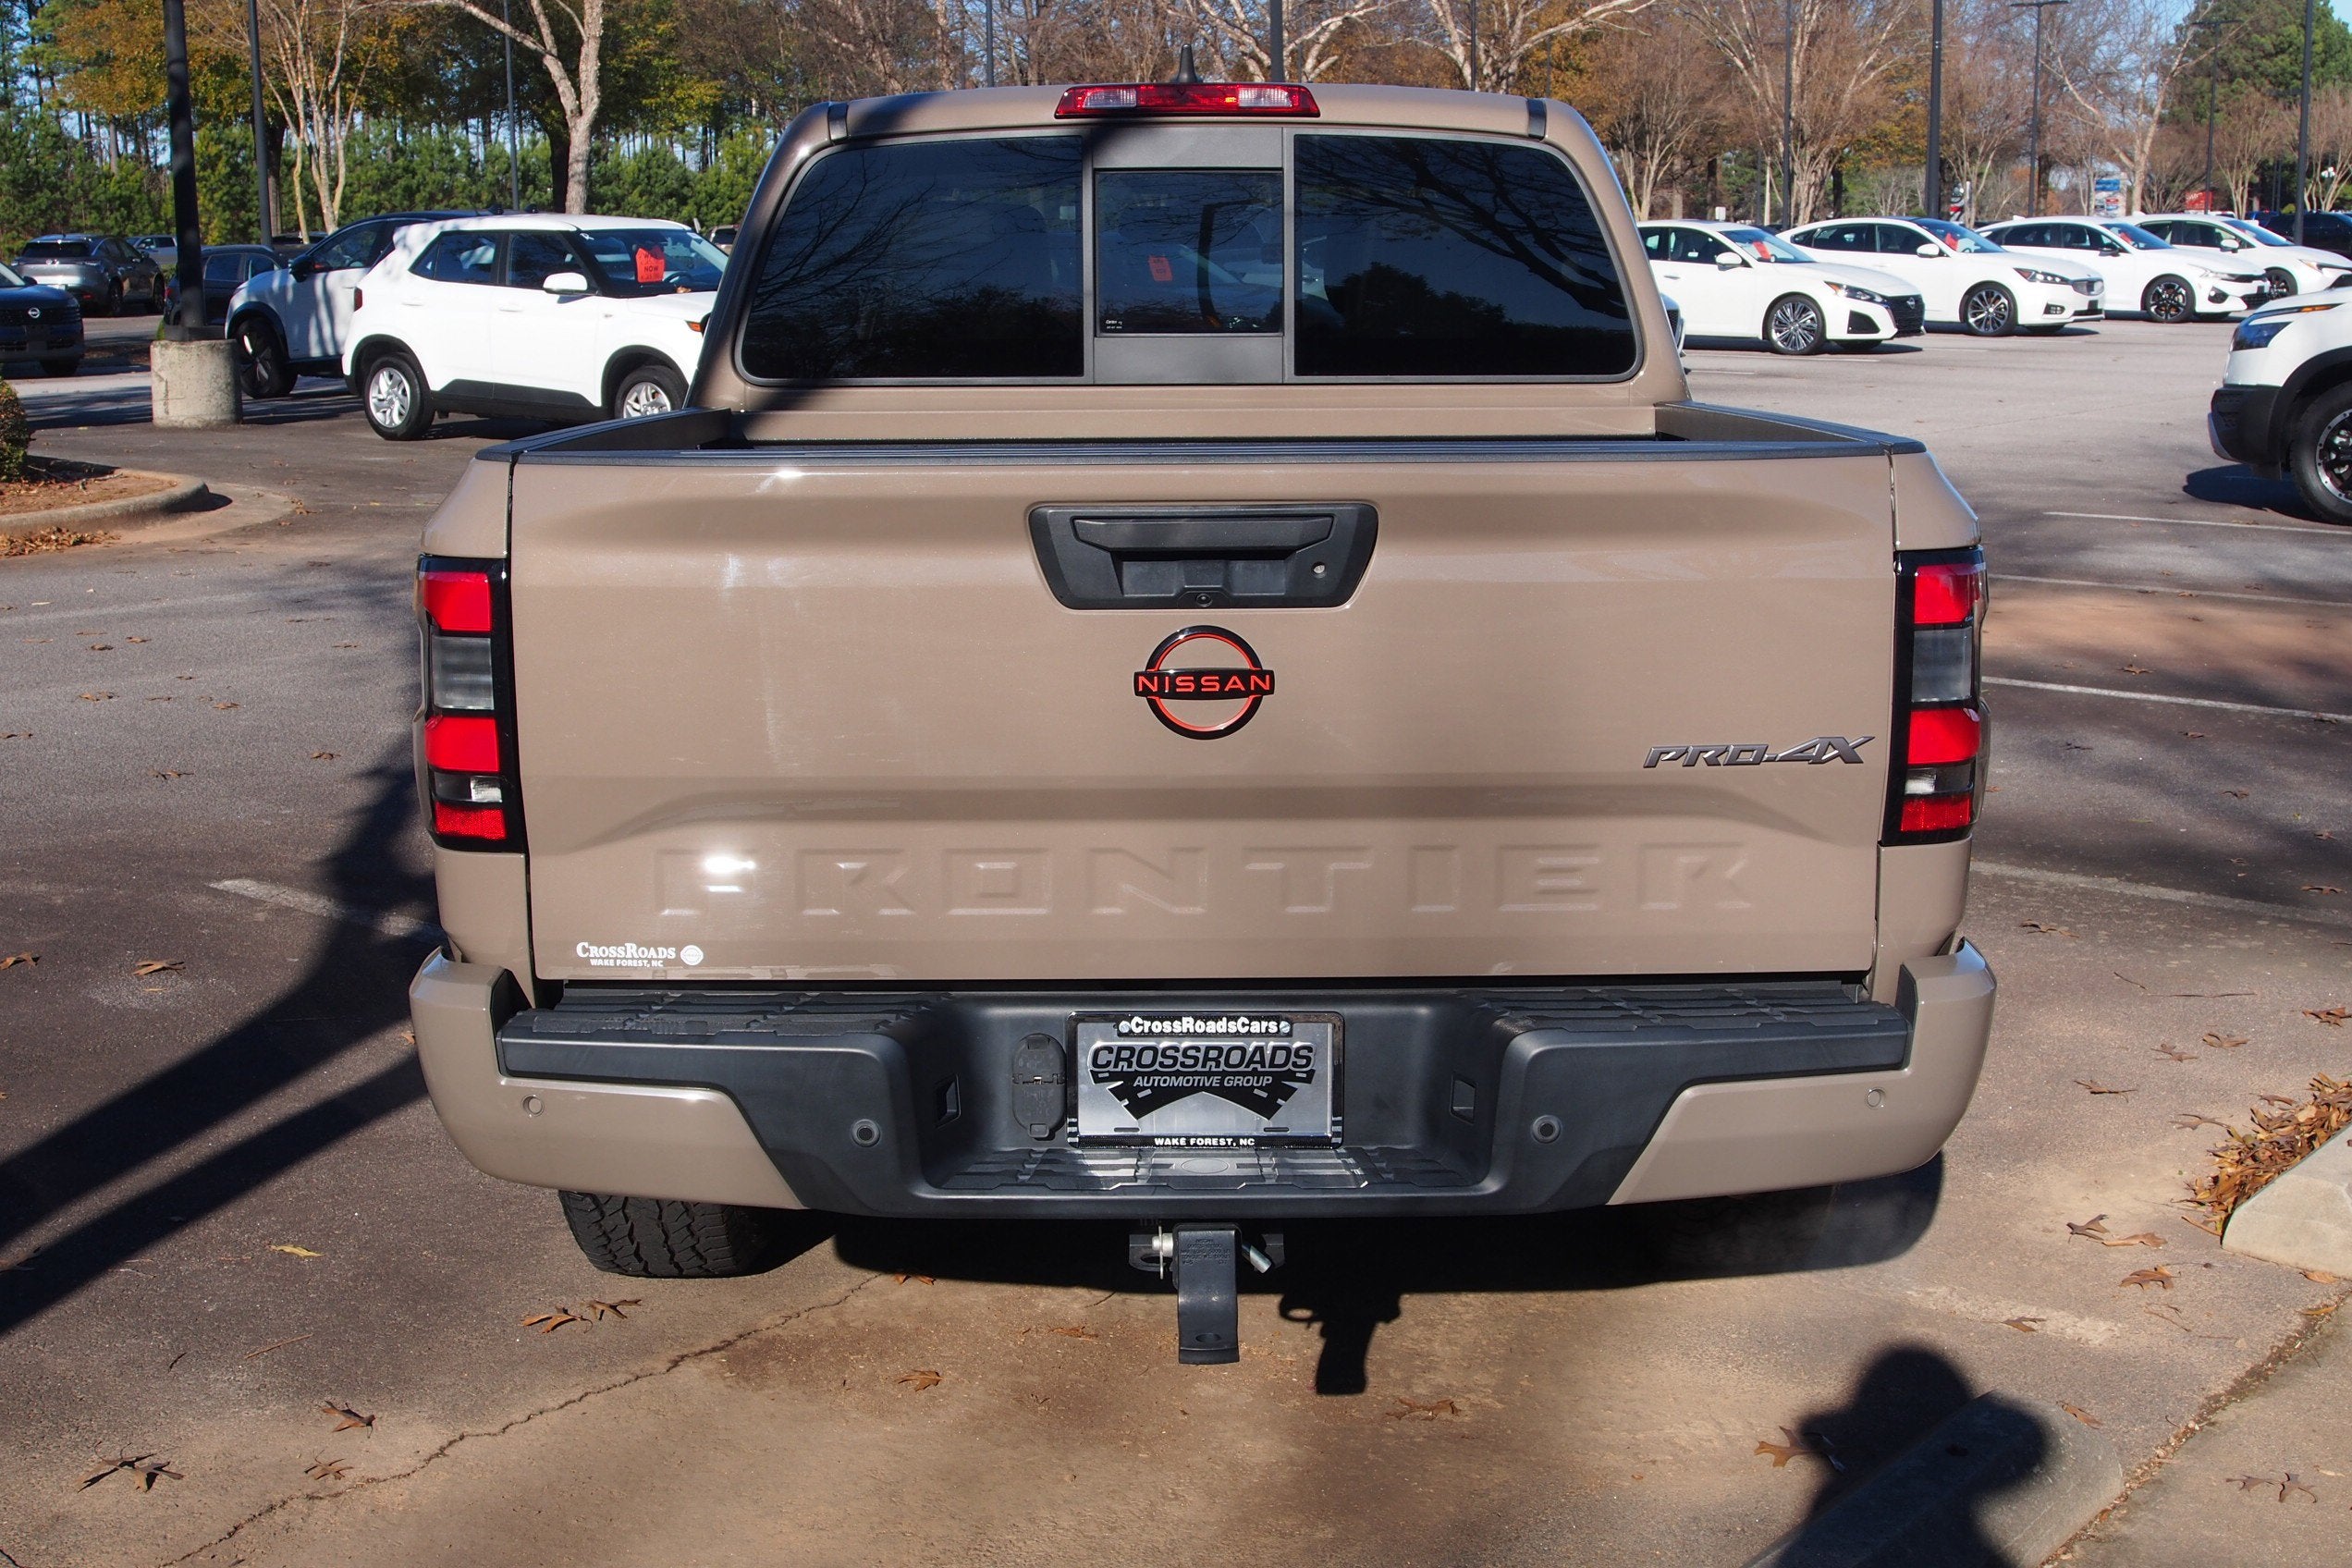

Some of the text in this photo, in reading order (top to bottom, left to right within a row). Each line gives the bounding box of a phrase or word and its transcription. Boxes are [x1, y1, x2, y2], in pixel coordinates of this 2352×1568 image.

[1138, 675, 1270, 692] NISSAN
[1643, 736, 1876, 768] PRO-4X
[655, 843, 1753, 916] FRONTIER
[590, 958, 664, 968] WAKE FOREST, NC
[1090, 1045, 1314, 1070] CROSSROADS
[1133, 1075, 1273, 1087] AUTOMOTIVE GROUP
[1154, 1137, 1256, 1146] WAKE FOREST, NC
